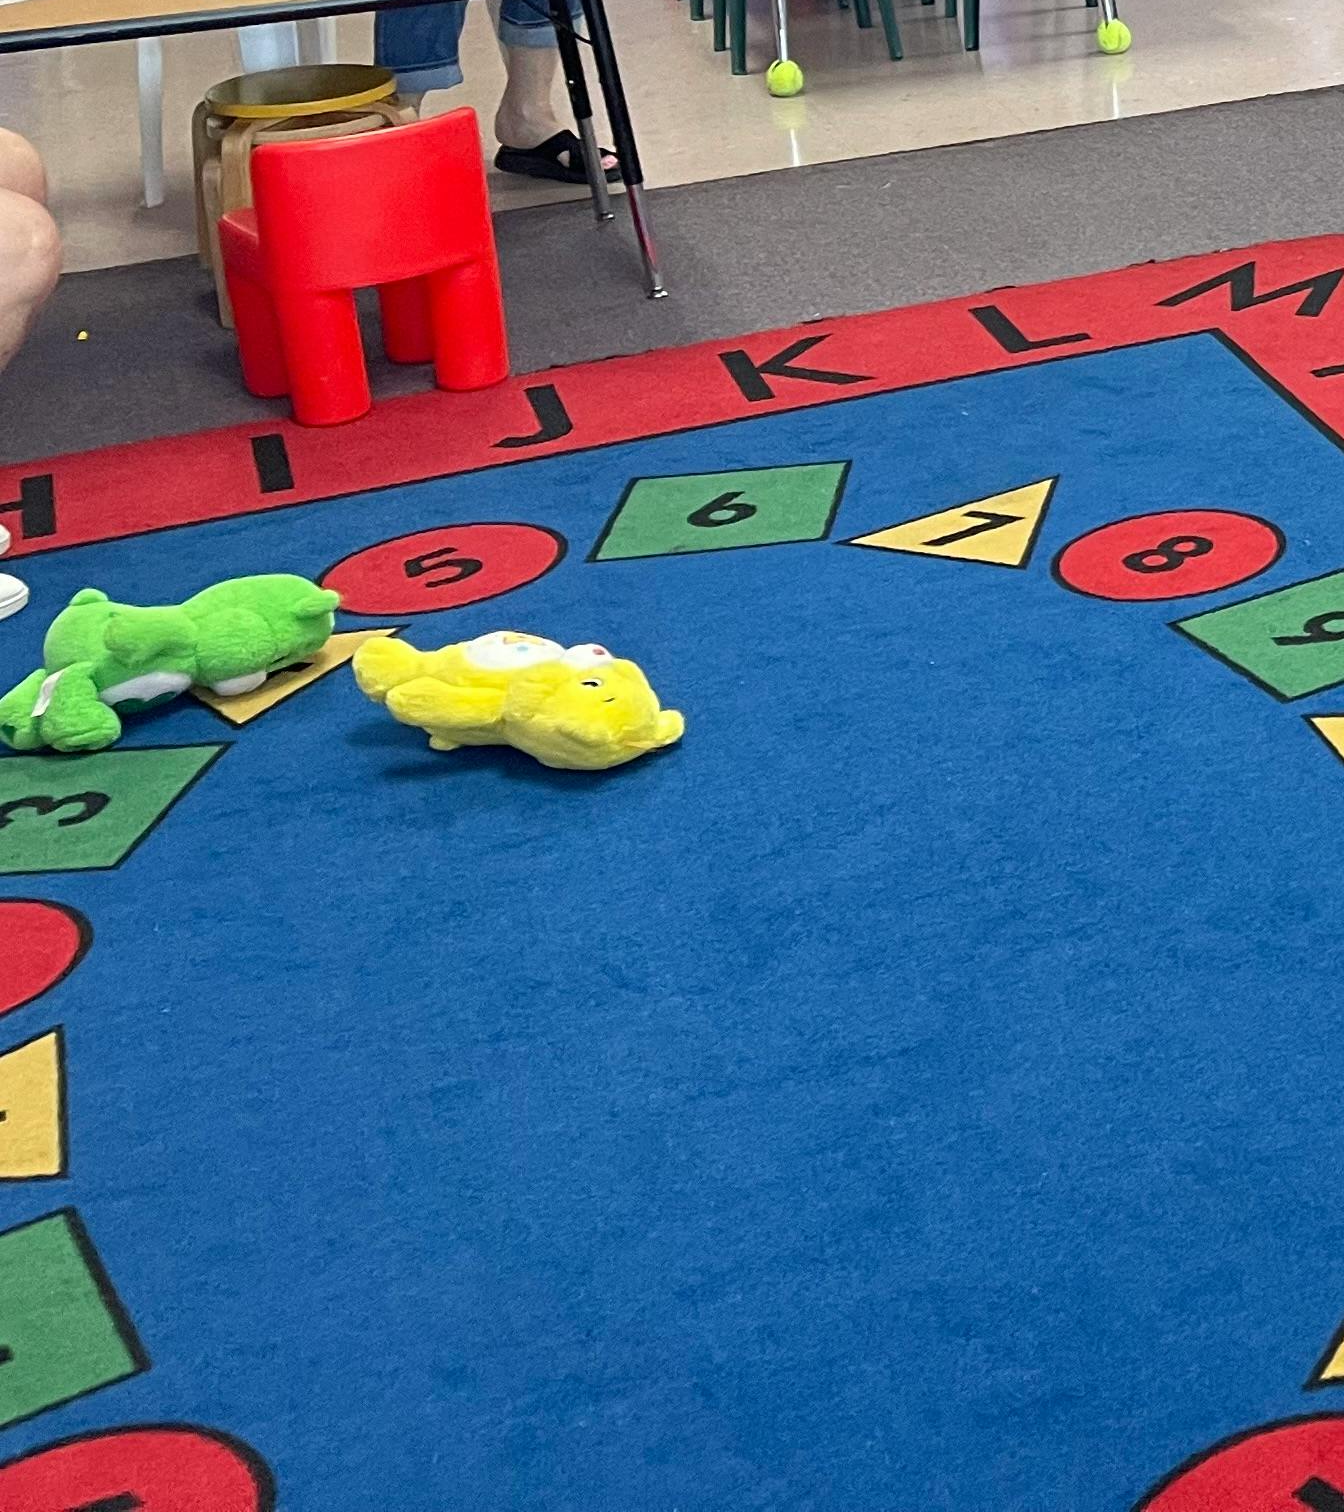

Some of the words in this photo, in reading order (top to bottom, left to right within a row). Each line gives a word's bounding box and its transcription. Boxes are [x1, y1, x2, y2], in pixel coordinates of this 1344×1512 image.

[251, 434, 294, 493] I
[492, 385, 575, 448] J
[719, 334, 874, 402] K
[971, 305, 1092, 355] L
[686, 491, 758, 528] 6
[920, 509, 1025, 549] 7
[405, 546, 484, 589] 5
[1121, 535, 1214, 575] 8
[0, 791, 111, 829] 3
